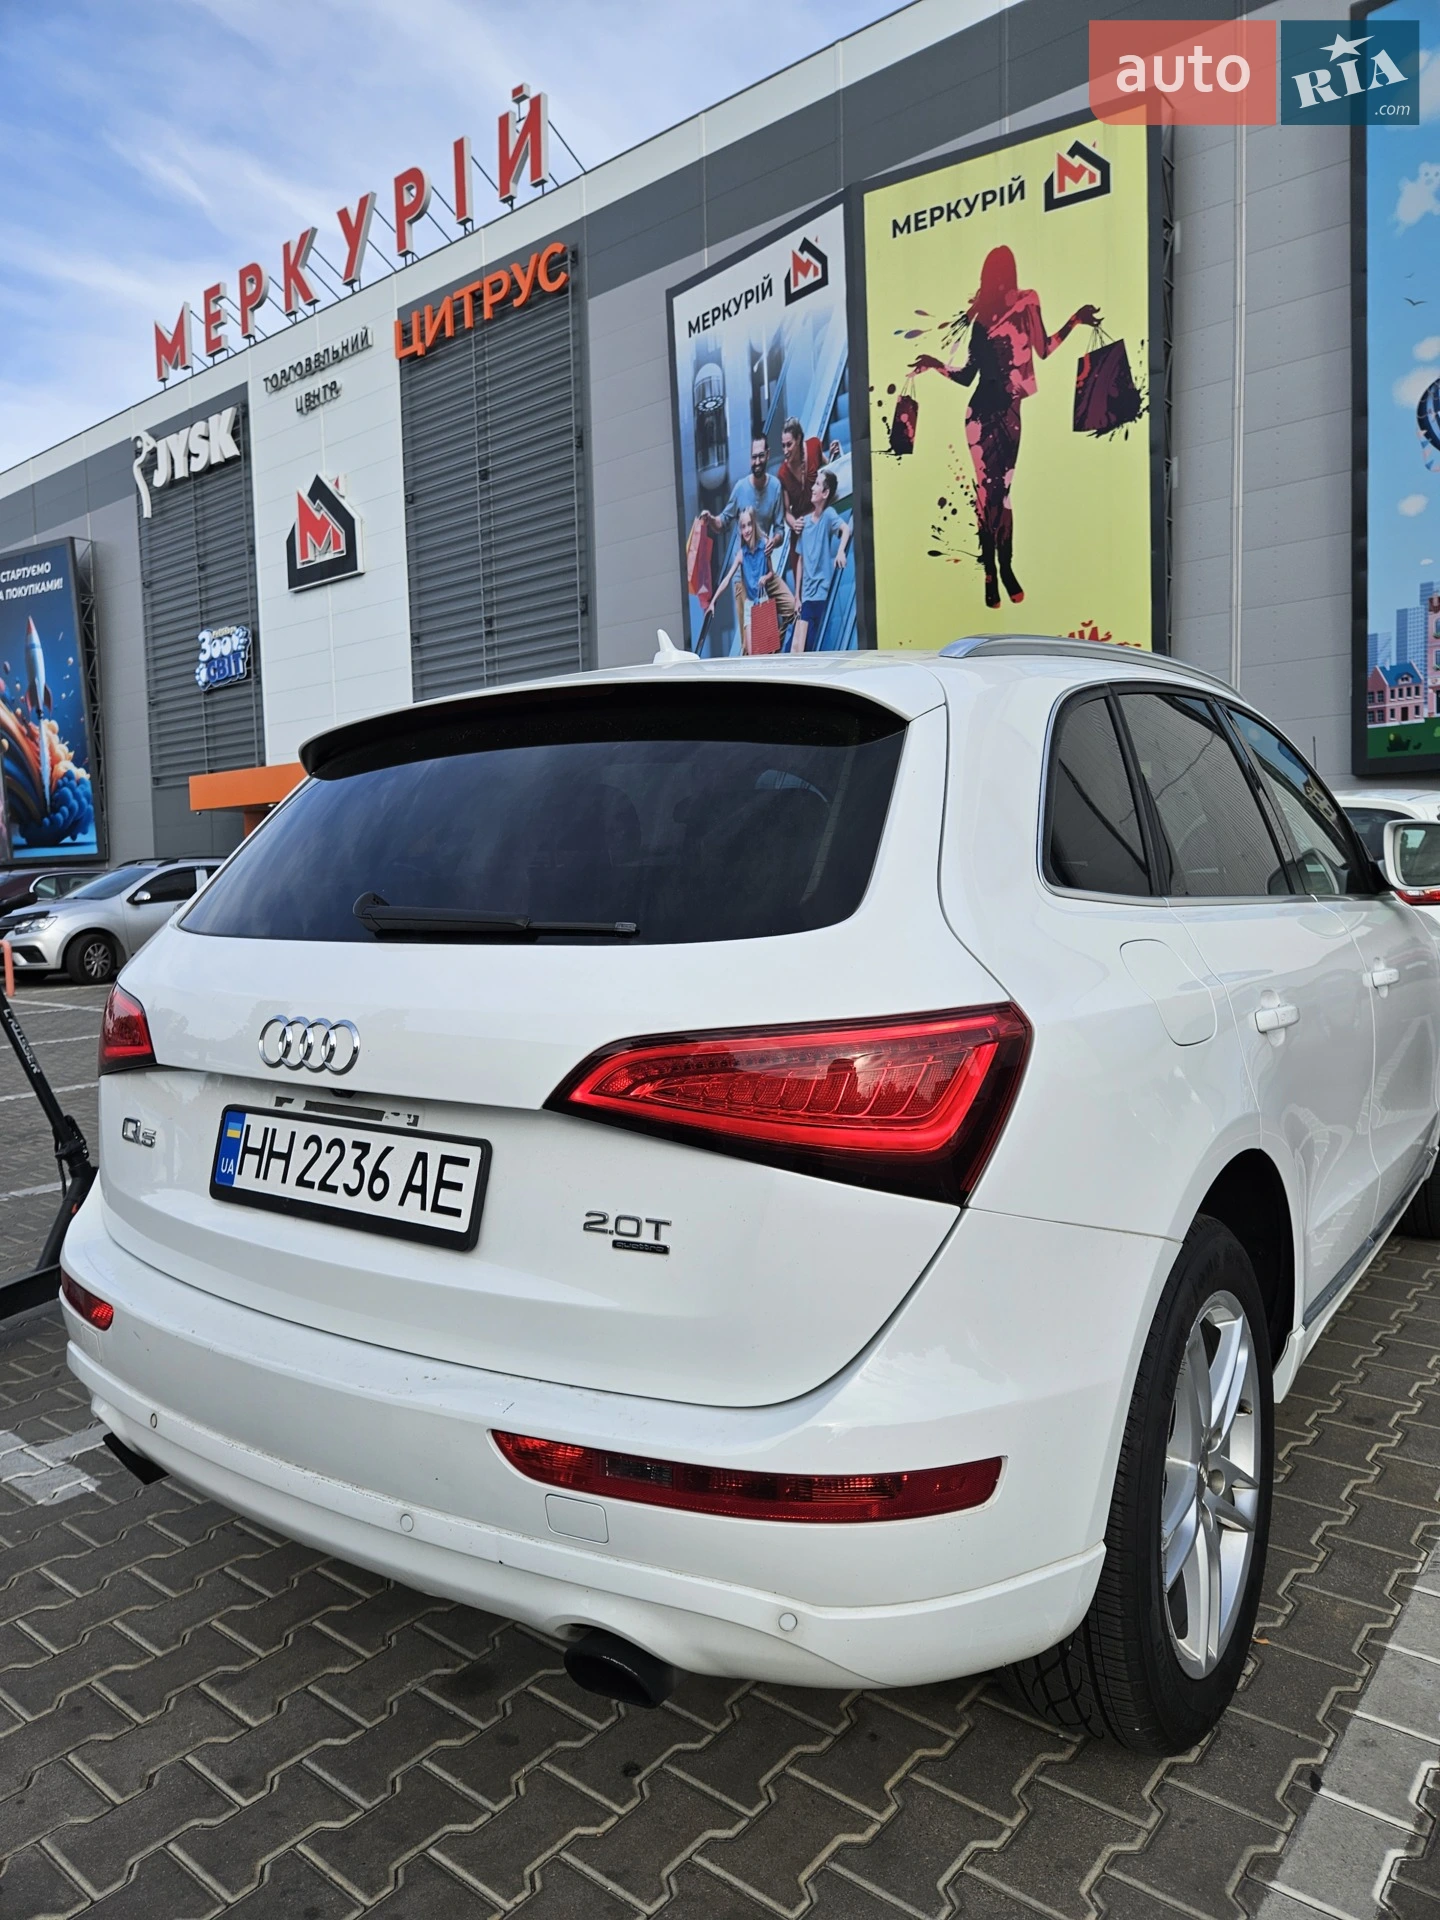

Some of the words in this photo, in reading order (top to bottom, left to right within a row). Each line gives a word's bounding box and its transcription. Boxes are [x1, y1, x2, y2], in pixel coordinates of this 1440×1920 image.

[154, 82, 549, 382] МЕРКУРІЙ
[891, 175, 1026, 239] МЕРКУРІЙ
[394, 241, 570, 360] ЦИТРУС
[687, 273, 773, 339] МЕРКУРІЙ
[263, 326, 371, 394] ТОРГОВЕЛЬНИЙ
[295, 380, 340, 414] ЦЕНТР
[153, 406, 241, 488] JYSK
[0, 561, 52, 583] СТАРТУЄМО
[5, 577, 64, 600] ПОКУПКАМИ!
[121, 1117, 157, 1149] Q5
[220, 1157, 234, 1175] UA
[237, 1123, 297, 1185] HH
[295, 1134, 395, 1202] 2236
[398, 1151, 471, 1219] AE
[583, 1211, 672, 1241] 2.0T
